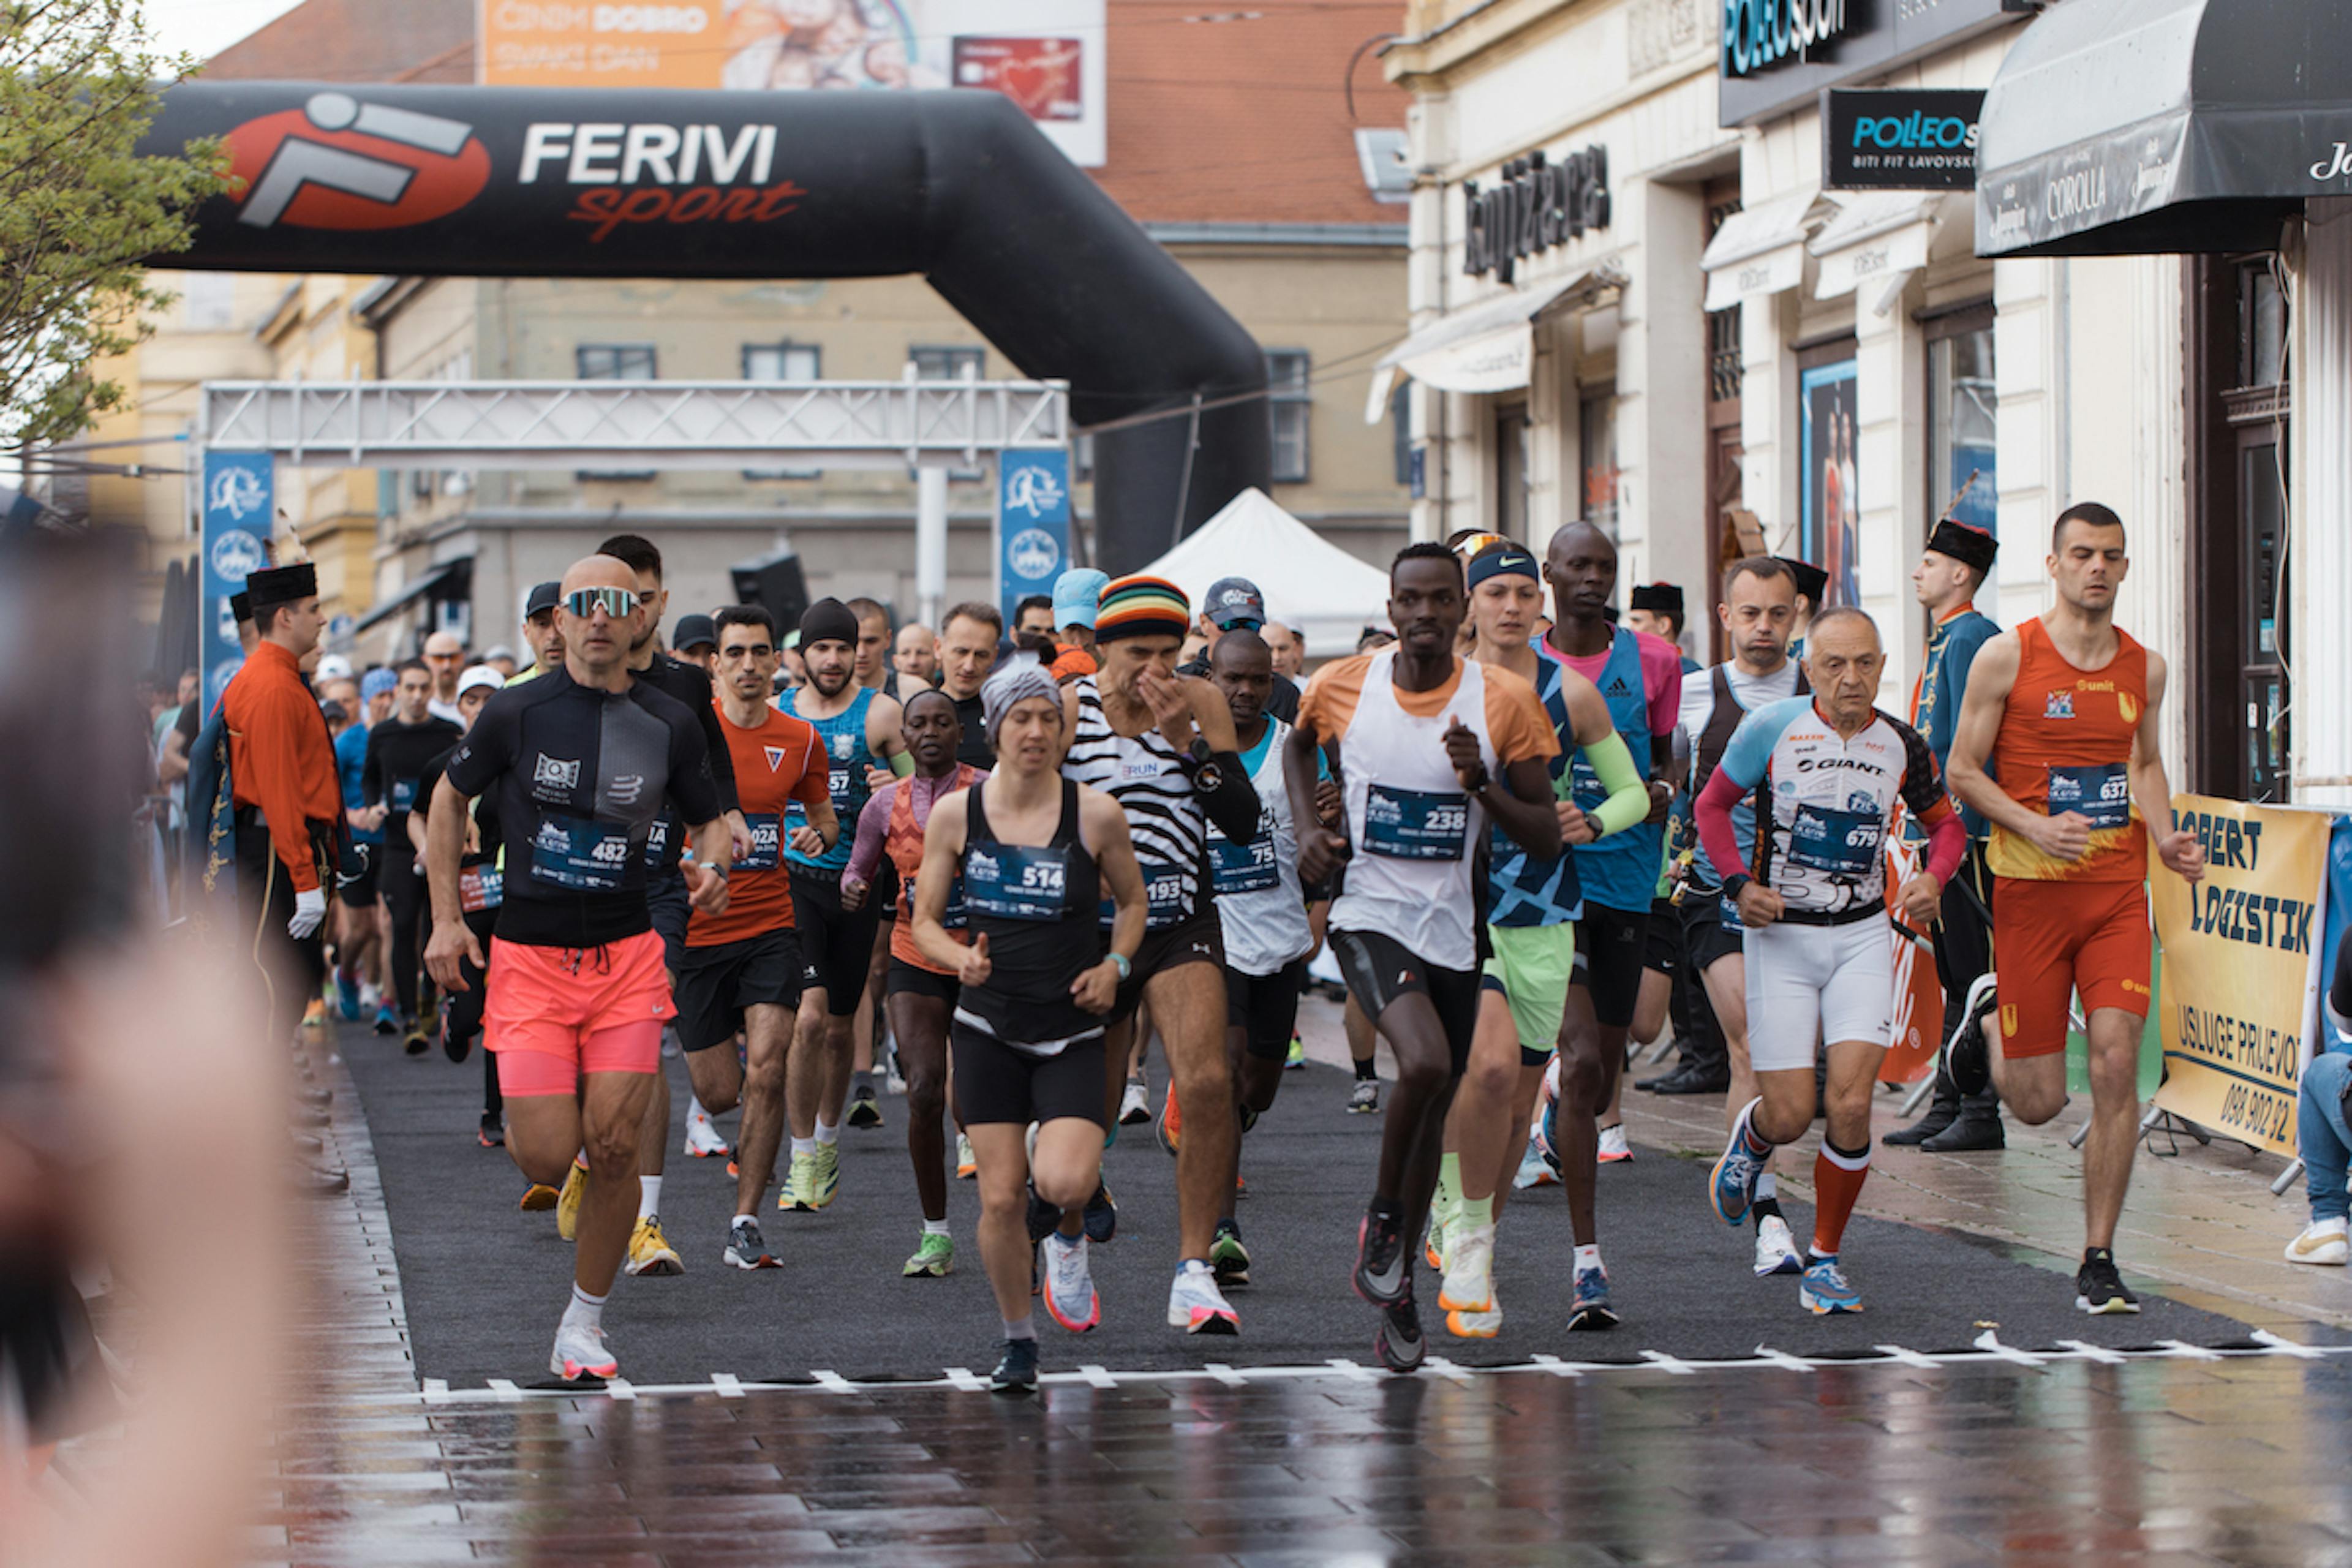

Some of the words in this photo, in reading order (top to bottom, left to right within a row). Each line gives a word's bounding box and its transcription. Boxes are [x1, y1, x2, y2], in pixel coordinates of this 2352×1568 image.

[593, 5, 708, 34] DOBRO
[589, 43, 660, 72] DAN
[518, 123, 777, 184] FERIVI
[1852, 155, 1879, 168] BITI
[1883, 155, 1904, 168] FIT
[2048, 165, 2106, 222] COROLLA
[567, 180, 808, 243] sport
[1817, 758, 1885, 775] GIANT
[2100, 782, 2127, 801] 637
[1424, 810, 1466, 831] 238
[1845, 829, 1879, 848] 679
[591, 842, 627, 862] 482
[1251, 846, 1275, 864] 75
[1022, 865, 1065, 888] 514
[1147, 881, 1182, 901] 193
[2191, 882, 2315, 955] LOGISTIK
[2177, 1003, 2233, 1061] USLUGE
